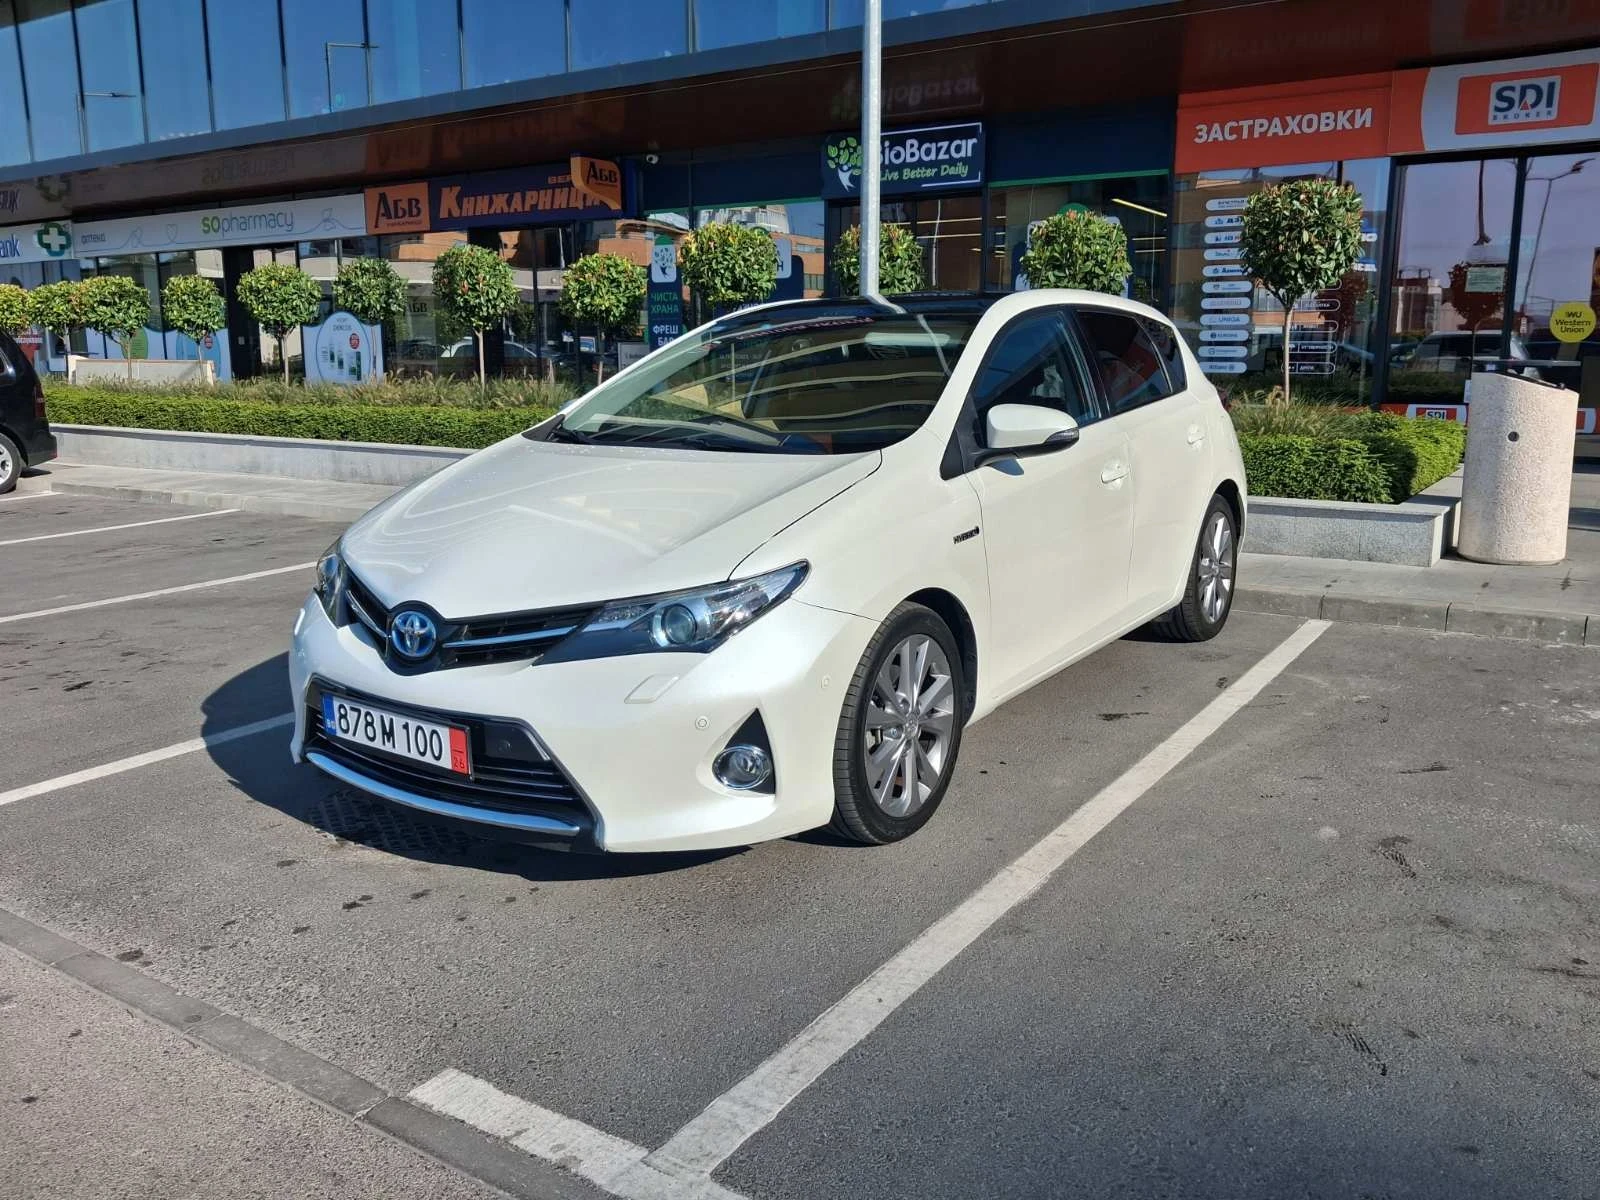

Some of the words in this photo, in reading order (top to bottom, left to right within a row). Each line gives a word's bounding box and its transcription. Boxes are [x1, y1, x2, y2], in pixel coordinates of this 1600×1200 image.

[1494, 81, 1556, 112] SDI
[1194, 107, 1373, 144] ЗАСТРАХОВКИ
[1493, 109, 1552, 121] BROKER
[880, 138, 978, 165] ioBazar
[902, 167, 938, 180] Better
[940, 161, 968, 177] Daily
[374, 191, 422, 229] АБВ
[201, 211, 295, 238] sopharmacy
[0, 234, 20, 258] ank
[650, 292, 679, 301] ЧИСТА
[650, 304, 679, 313] ХРАНА
[652, 324, 679, 334] ФРЕШ
[337, 703, 377, 742] 878
[380, 714, 396, 749] M
[402, 721, 443, 761] 100
[453, 756, 465, 769] 26
